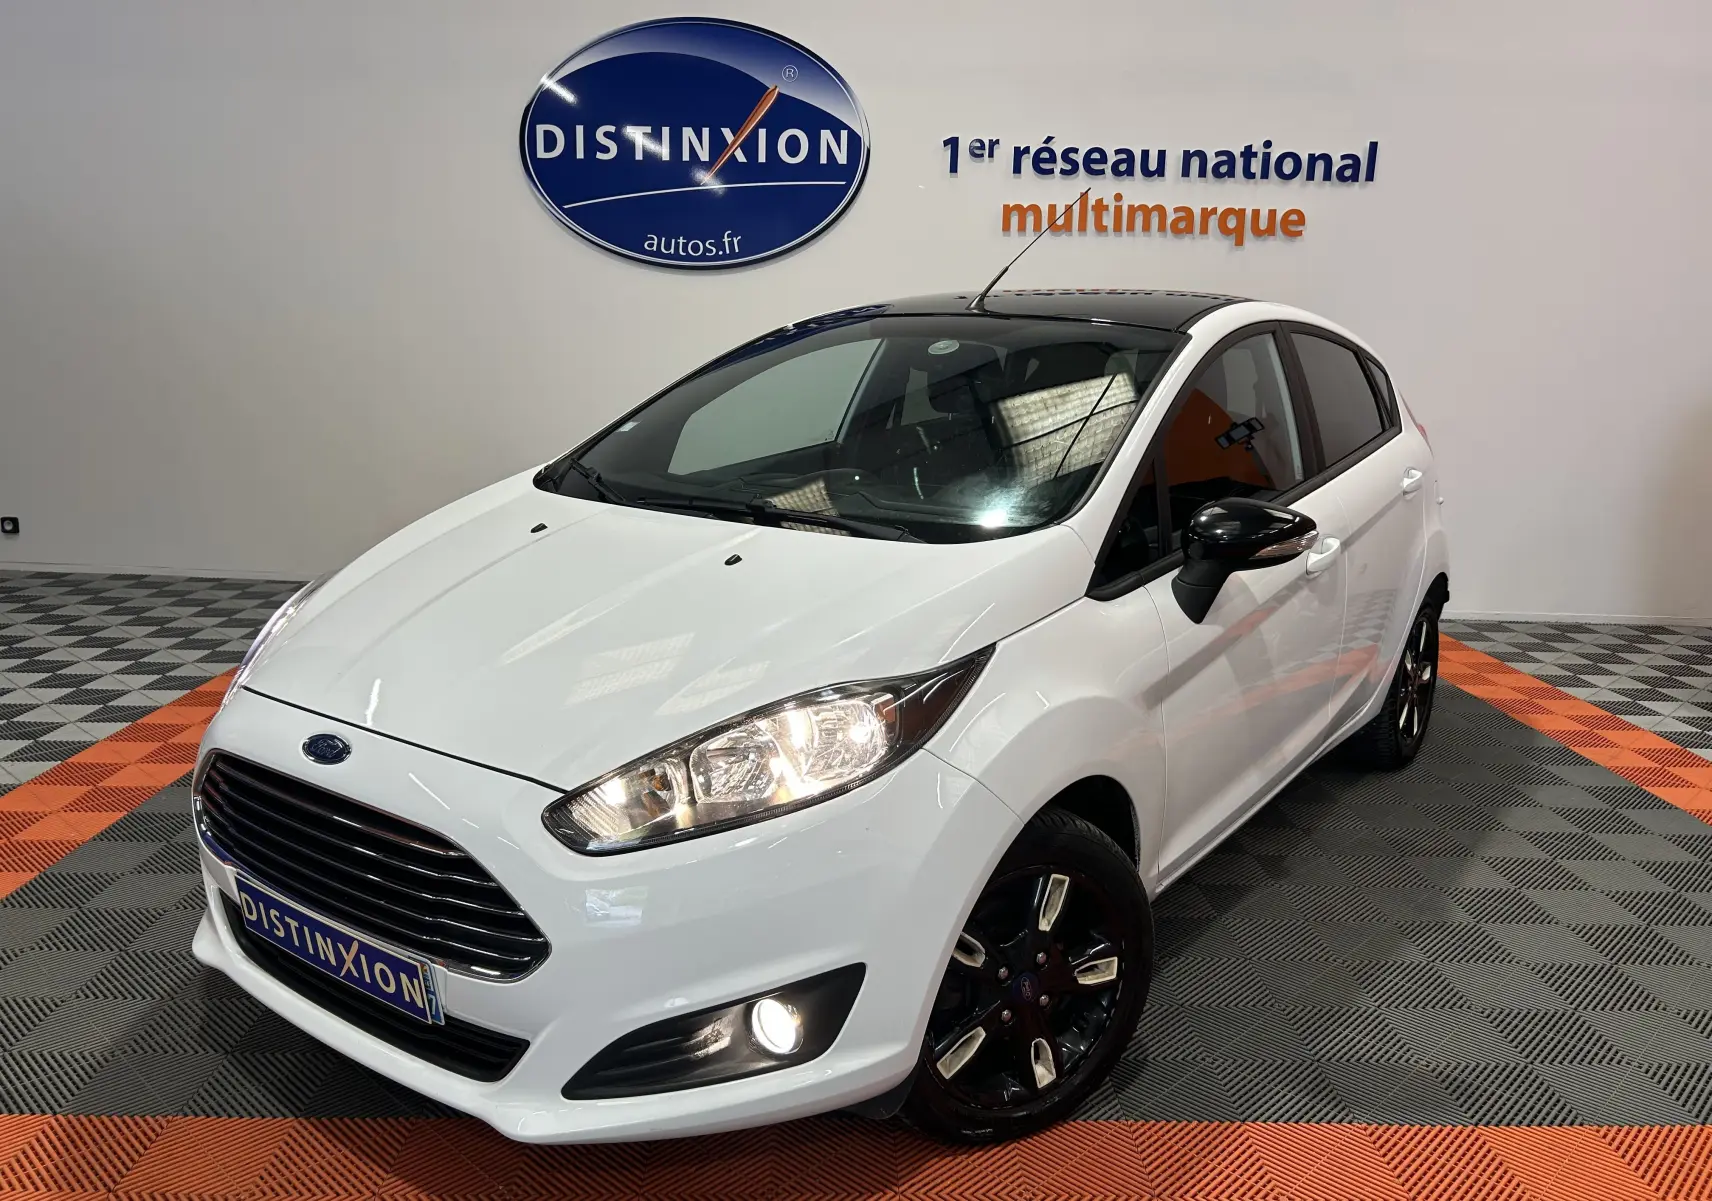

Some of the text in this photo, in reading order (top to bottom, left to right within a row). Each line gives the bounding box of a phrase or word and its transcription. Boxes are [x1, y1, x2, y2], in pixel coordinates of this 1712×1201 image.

[535, 124, 848, 164] DISTINXION
[1012, 136, 1167, 178] réseau
[1181, 140, 1379, 183] national
[644, 230, 742, 256] autos.fr
[1001, 192, 1307, 247] multimarque
[239, 890, 424, 1008] DISTINXION
